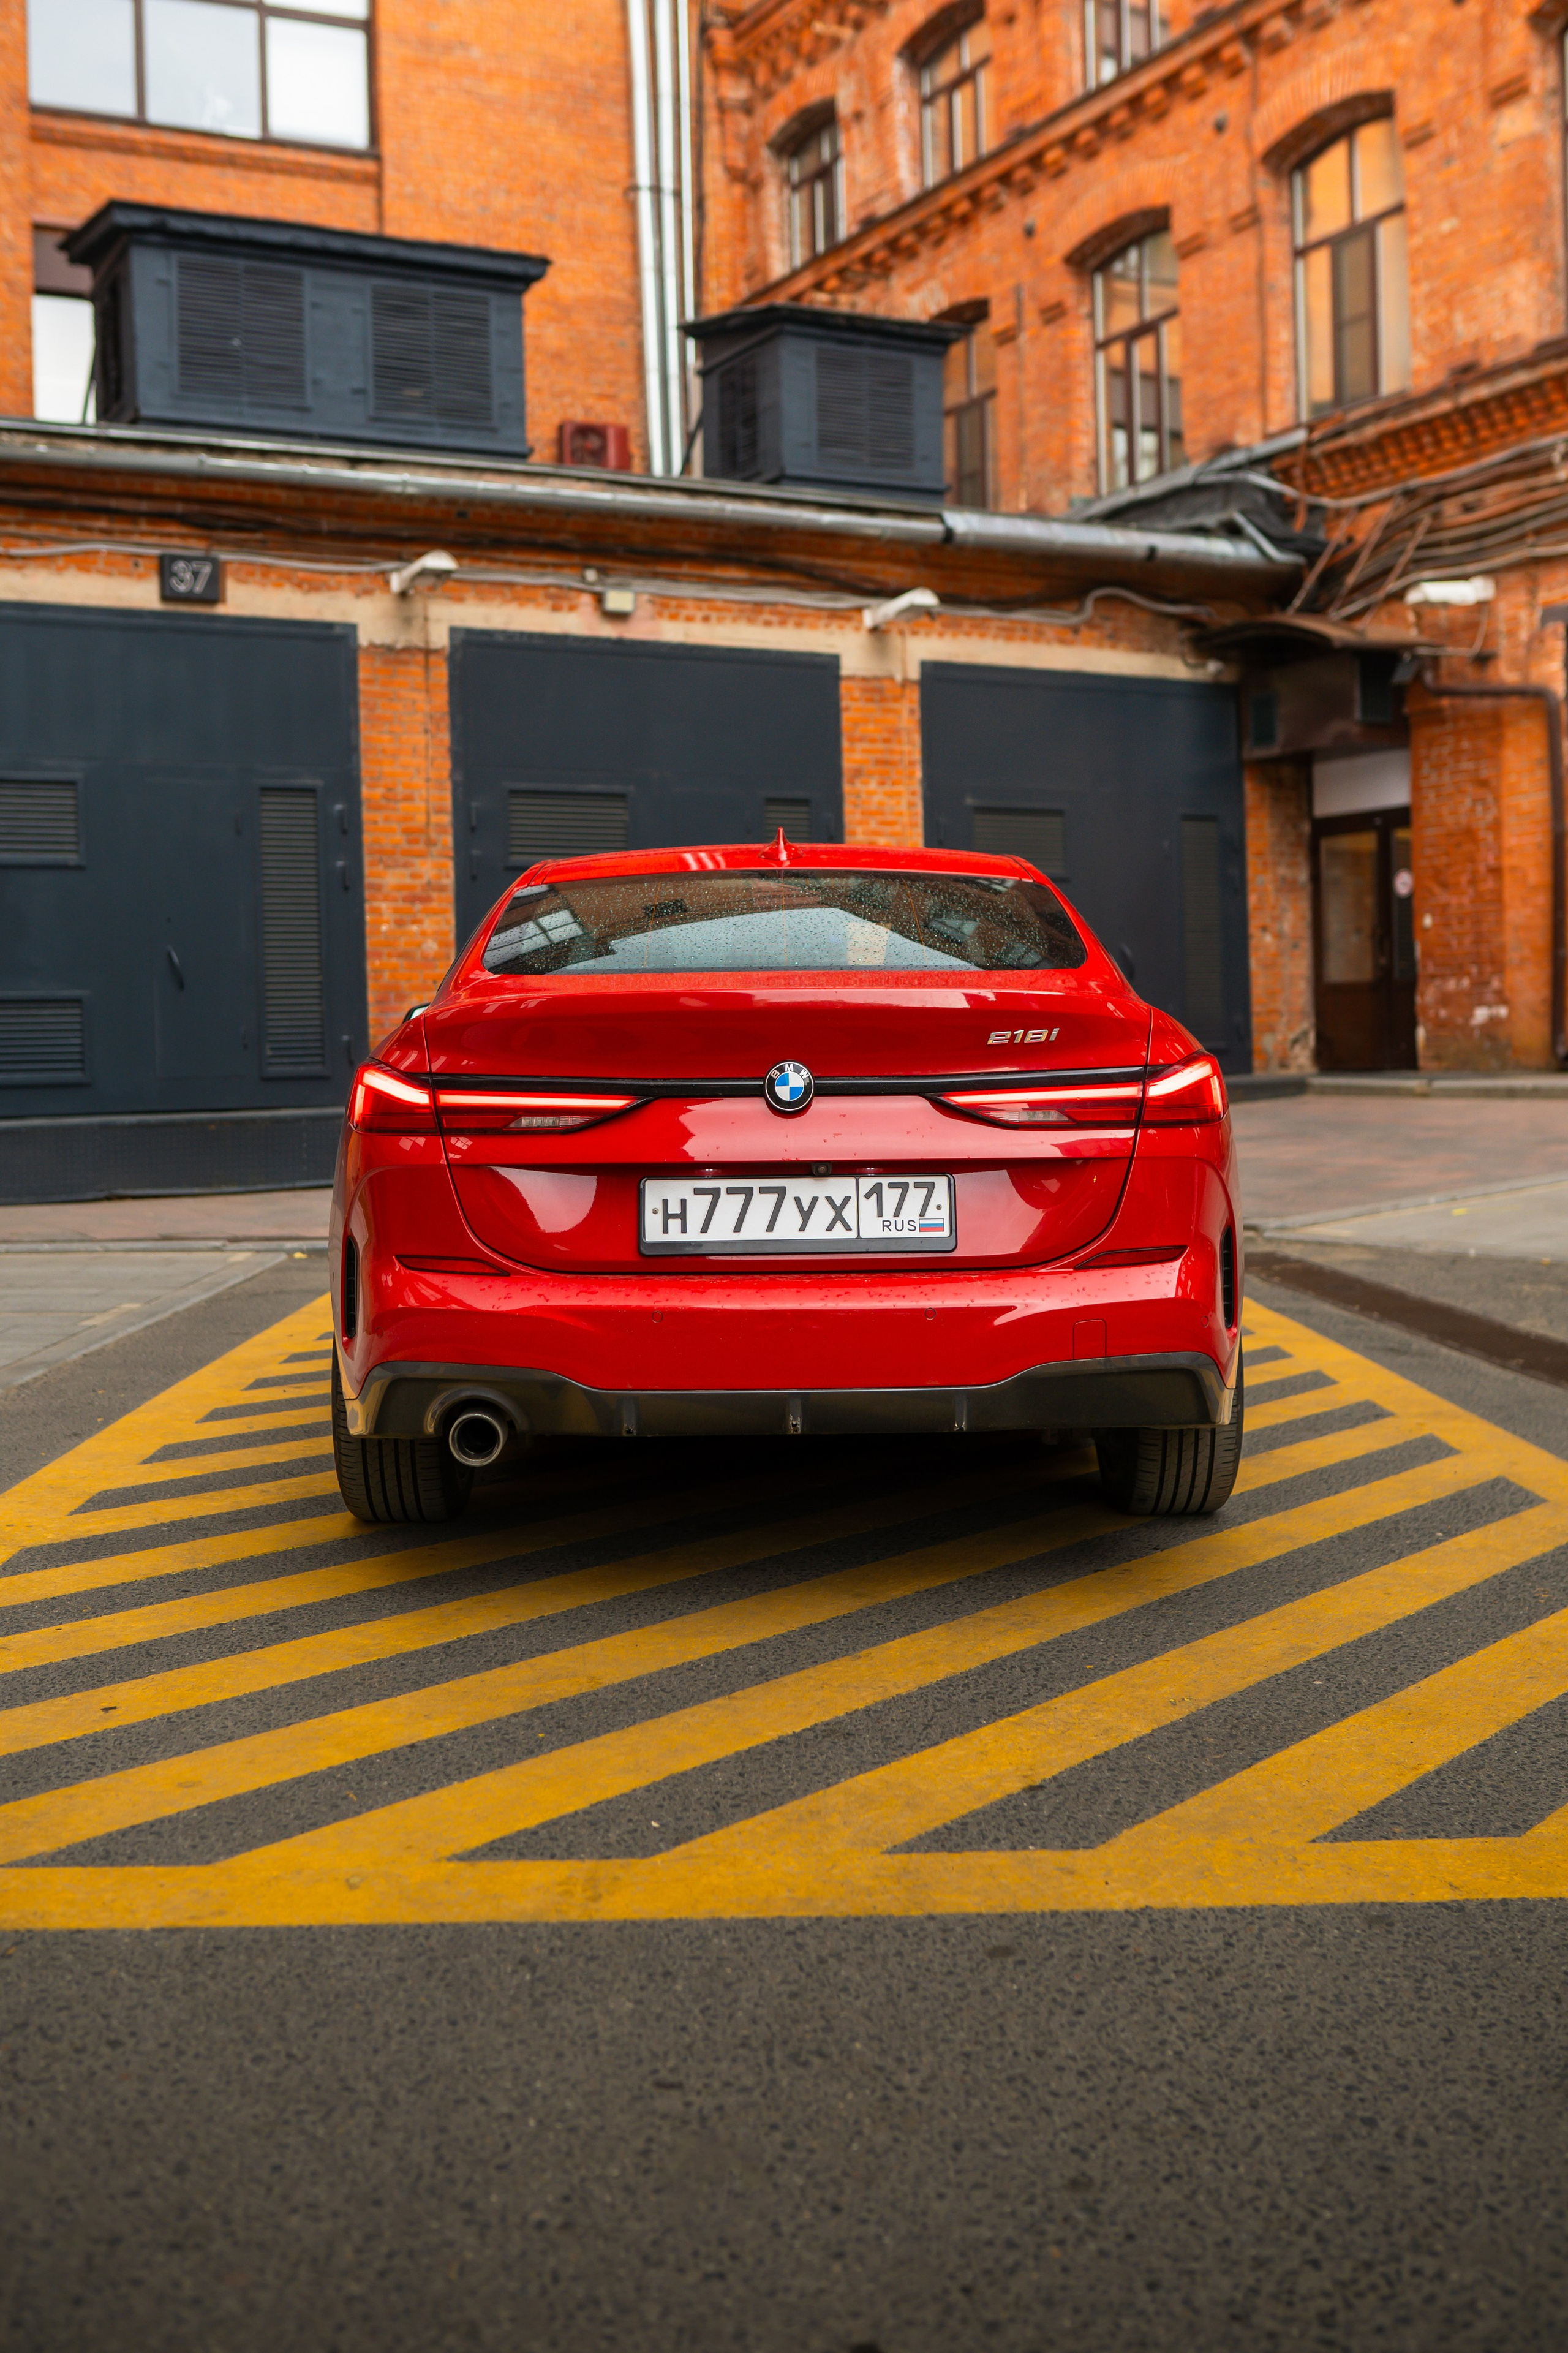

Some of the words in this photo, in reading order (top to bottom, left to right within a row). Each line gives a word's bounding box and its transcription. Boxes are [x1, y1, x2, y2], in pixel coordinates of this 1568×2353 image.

[169, 559, 213, 594] 37
[987, 1028, 1060, 1045] 218i
[771, 1063, 810, 1079] BMW
[864, 1182, 935, 1217] 177
[882, 1219, 917, 1233] RUS
